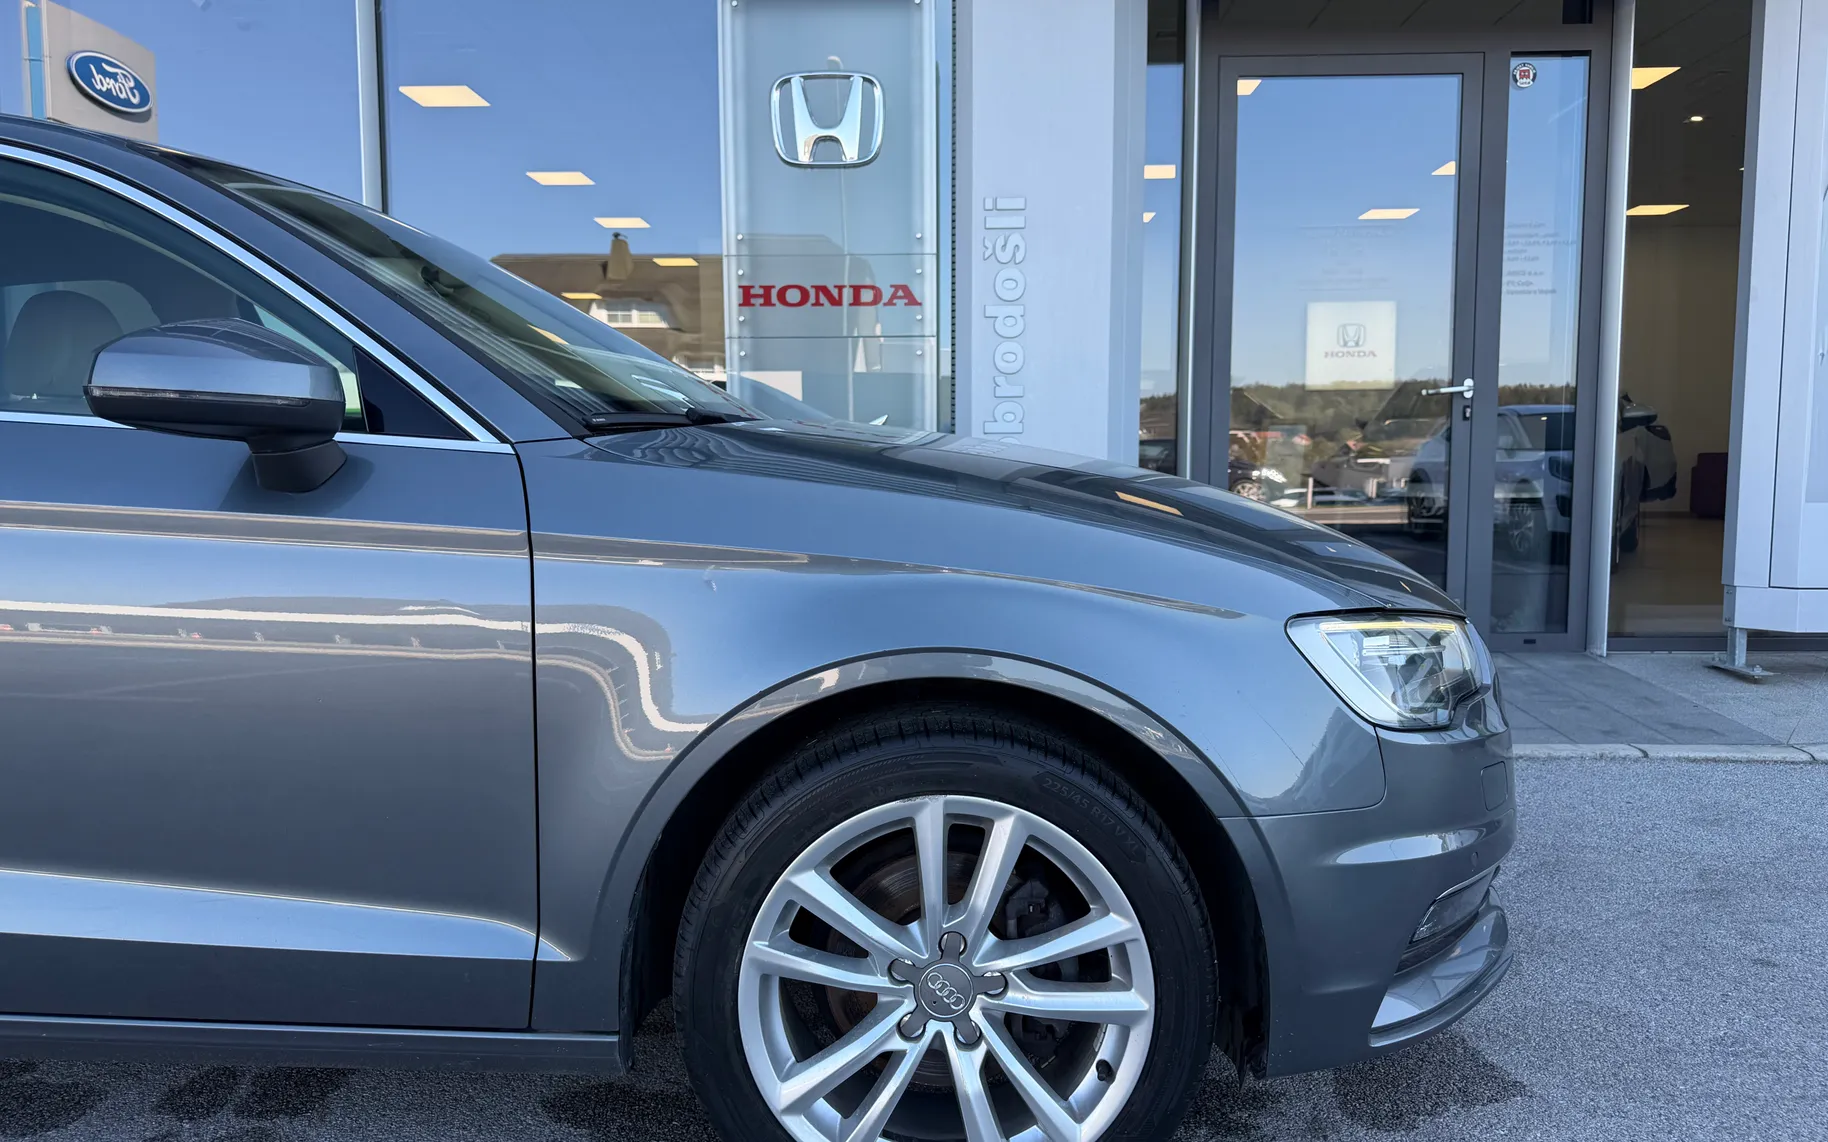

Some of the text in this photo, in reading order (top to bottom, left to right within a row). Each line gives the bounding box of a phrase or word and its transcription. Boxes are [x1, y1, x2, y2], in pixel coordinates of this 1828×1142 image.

[738, 284, 922, 308] HONDA
[983, 196, 1027, 444] brodošli
[1324, 350, 1377, 359] HONDA
[1042, 777, 1090, 809] 225/45
[1090, 806, 1115, 826] R17
